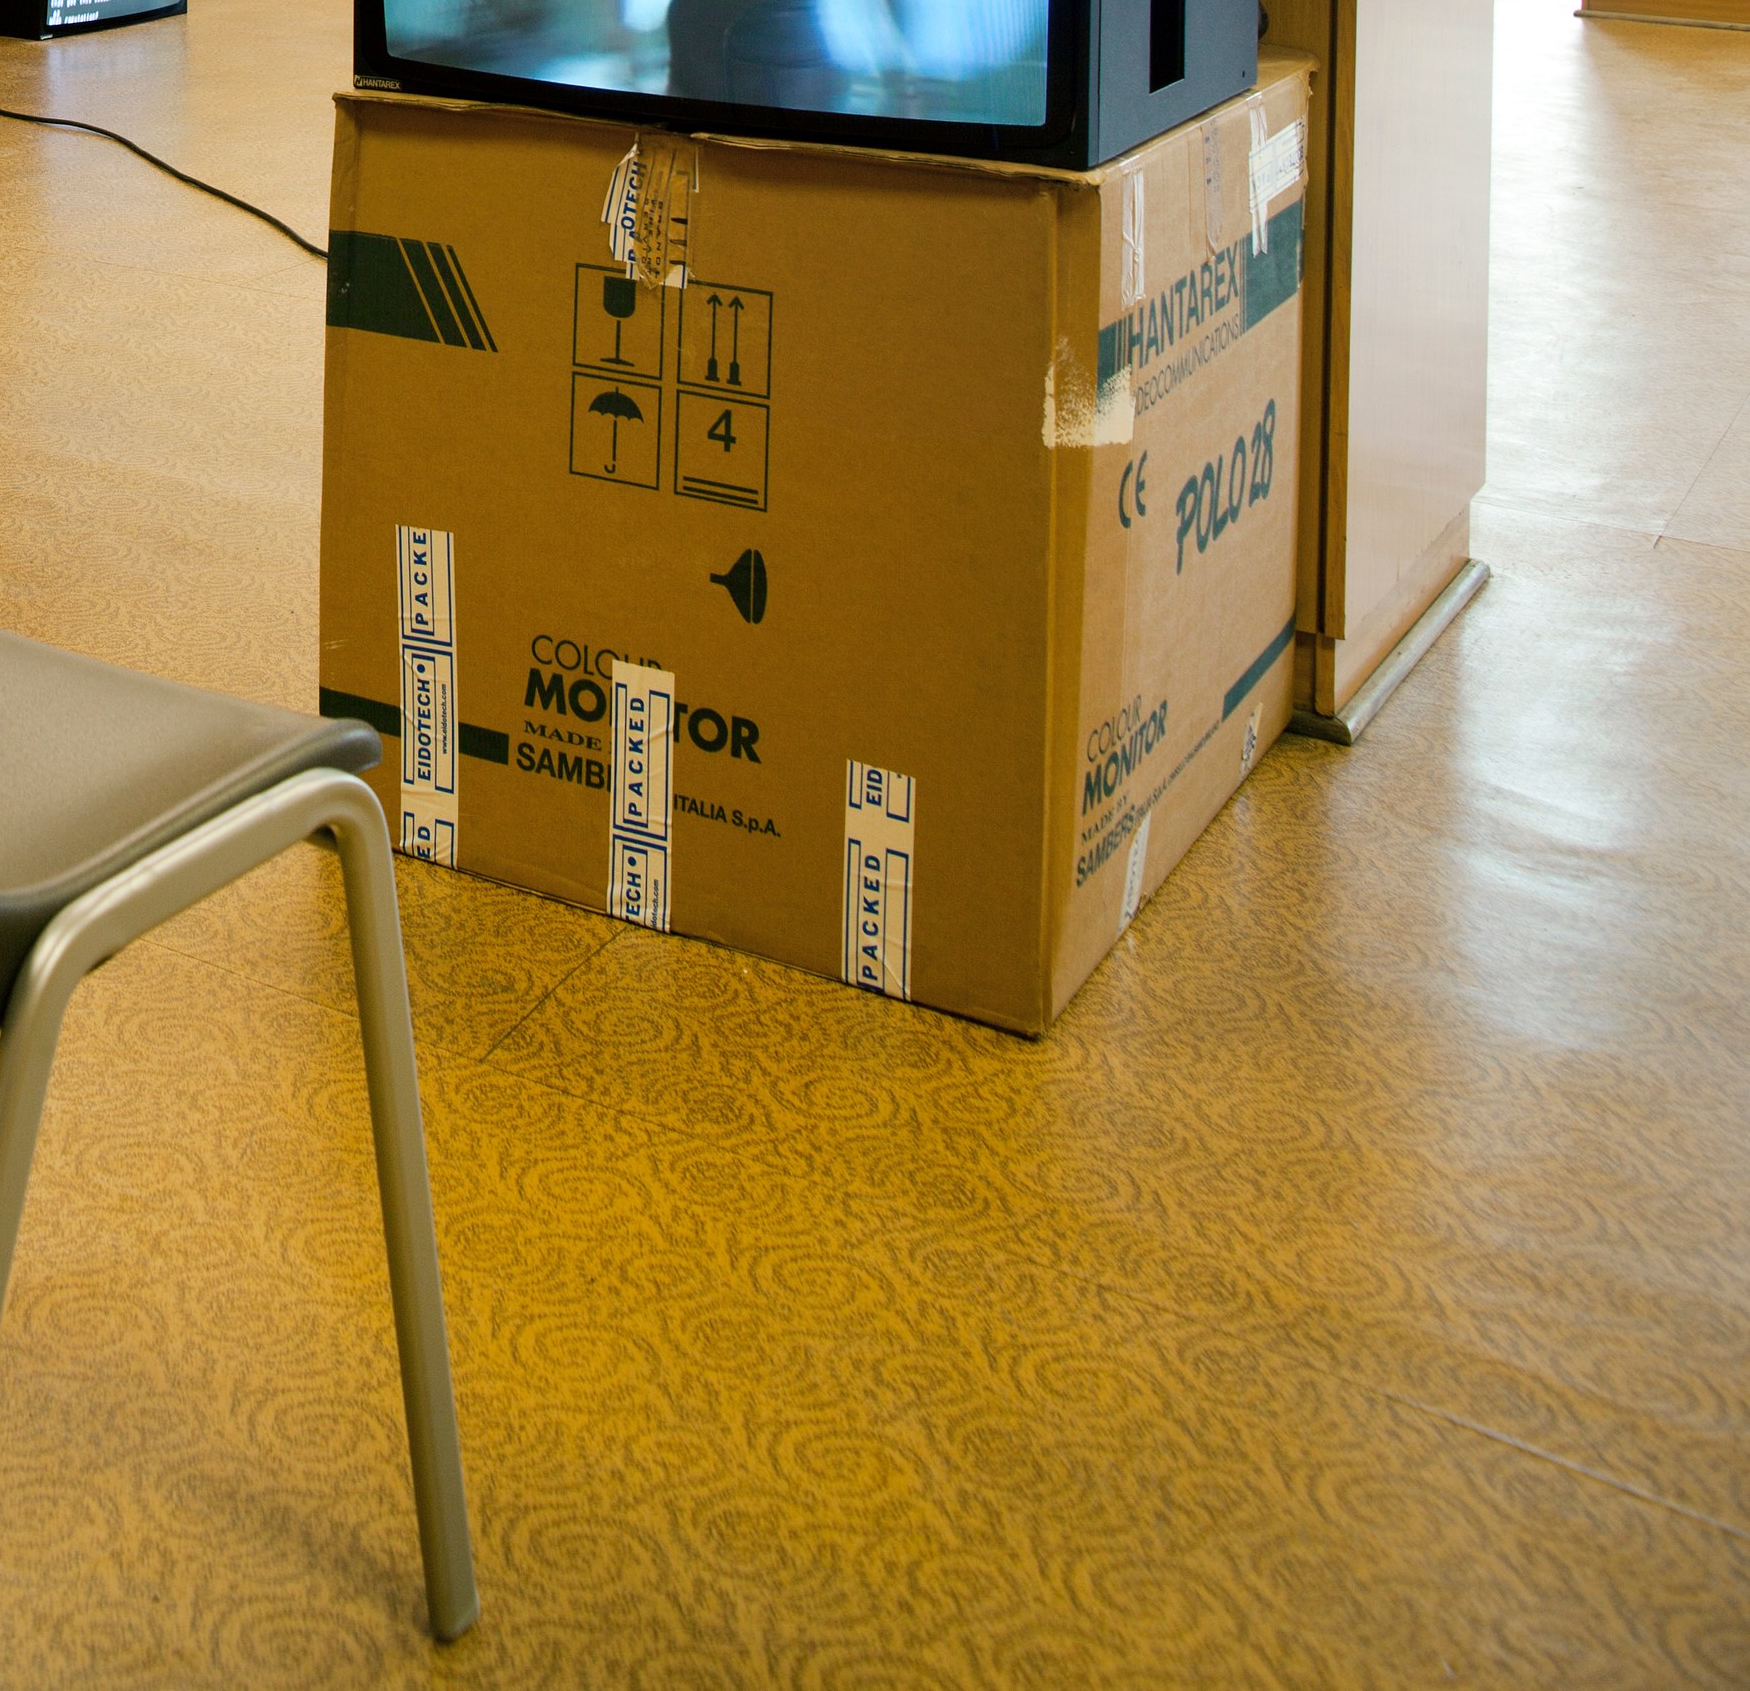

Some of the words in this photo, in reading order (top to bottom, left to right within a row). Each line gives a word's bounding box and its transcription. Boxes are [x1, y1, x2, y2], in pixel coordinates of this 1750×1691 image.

[363, 78, 401, 90] HANTAREX
[1130, 240, 1240, 372] HANTAREX
[707, 409, 736, 452] 4
[1176, 454, 1247, 575] POLO
[1249, 398, 1276, 508] 28
[416, 678, 431, 781] EIDOTECH
[440, 683, 448, 755] www.eidotech.com
[524, 668, 762, 764] MOTOR
[524, 720, 602, 752] MADE
[627, 697, 645, 818] PACKED
[1083, 699, 1168, 816] MONITOR
[1087, 695, 1142, 763] COLOUR
[673, 794, 727, 824] ITALIA
[732, 809, 782, 838] S.p.A.
[862, 854, 881, 981] PACKED
